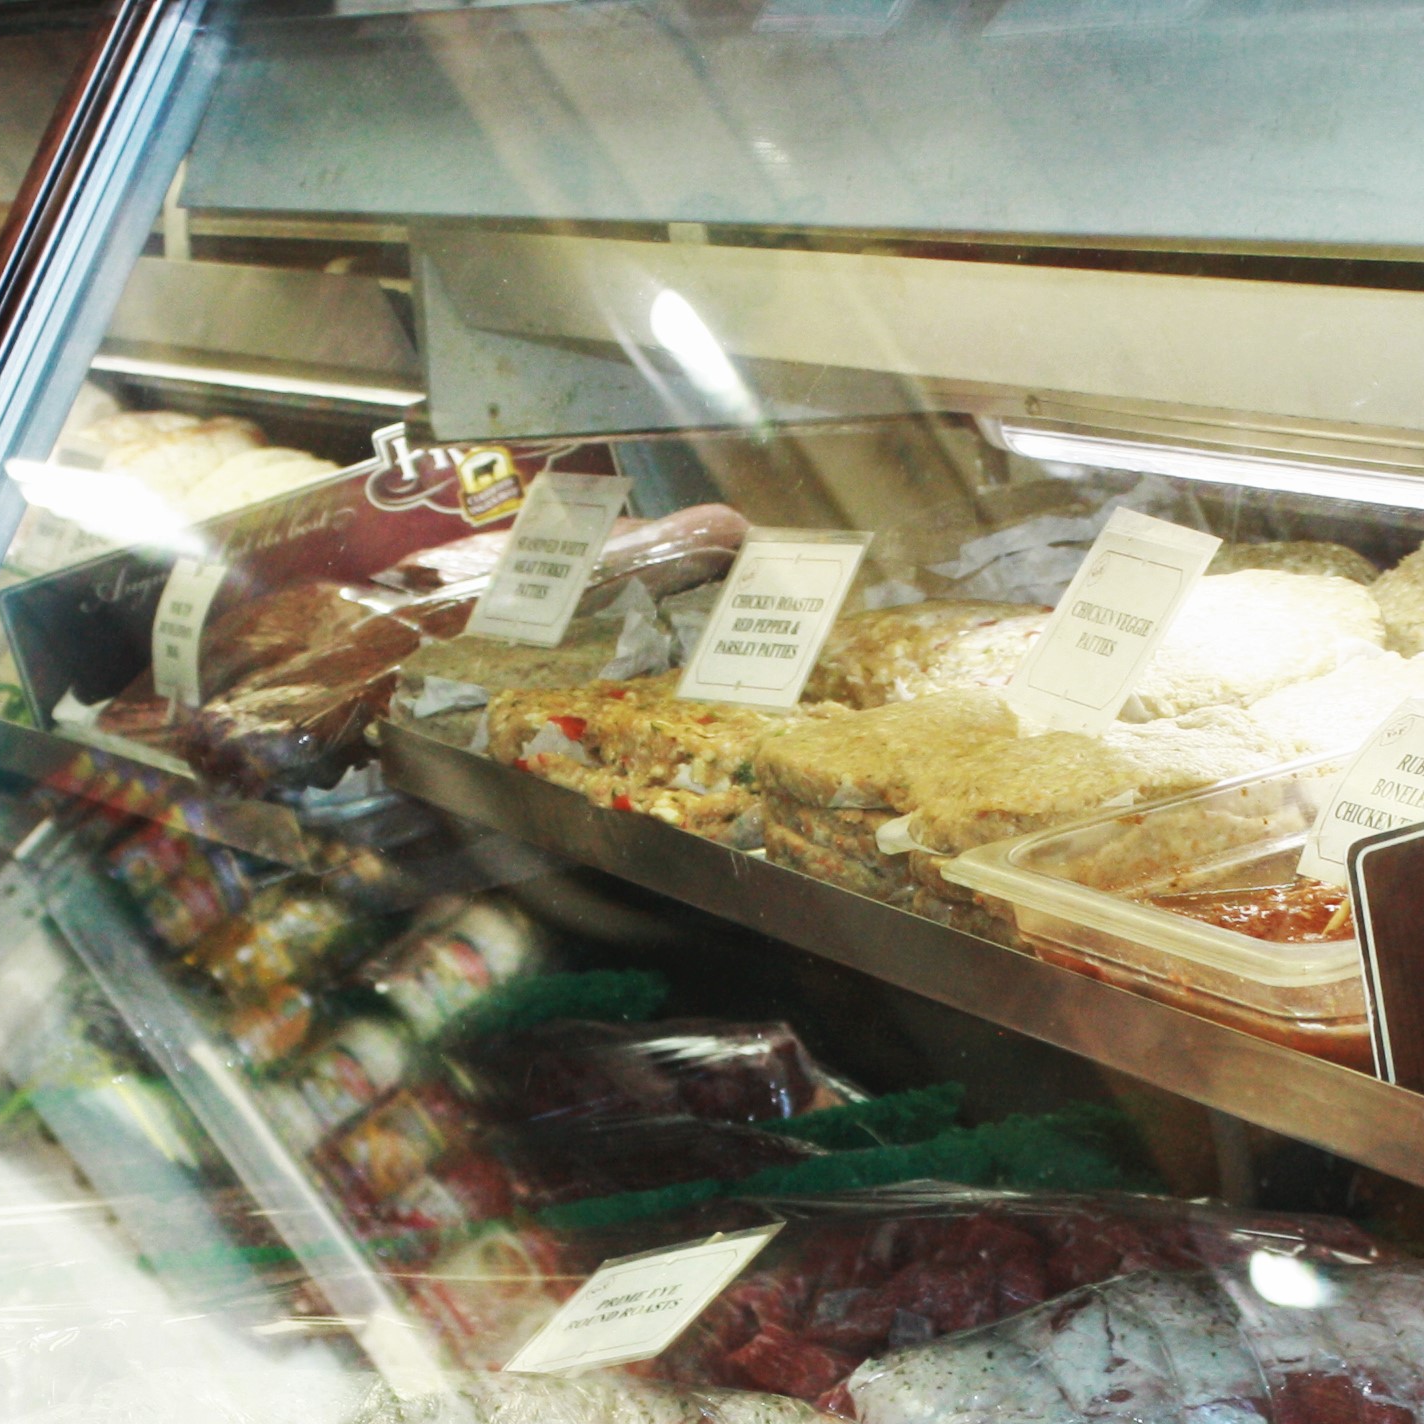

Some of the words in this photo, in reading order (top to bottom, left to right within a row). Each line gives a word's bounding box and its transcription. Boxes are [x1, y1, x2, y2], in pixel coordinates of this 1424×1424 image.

[732, 595, 776, 611] CHICKEN
[776, 596, 824, 612] ROASTED
[732, 617, 753, 633] RED
[753, 618, 790, 635] PEPPER
[790, 620, 800, 635] &
[1071, 600, 1117, 627] CHICKEN
[1113, 611, 1154, 638] VEGGIE
[714, 639, 759, 657] PARSLEY
[757, 641, 799, 659] PATTIES
[1075, 632, 1118, 657] PATTIES
[1334, 800, 1394, 830] CHICKEN
[595, 1291, 645, 1311] PRIME
[646, 1283, 682, 1299] EYE
[564, 1308, 620, 1331] ROUND
[620, 1299, 684, 1318] ROASTS
